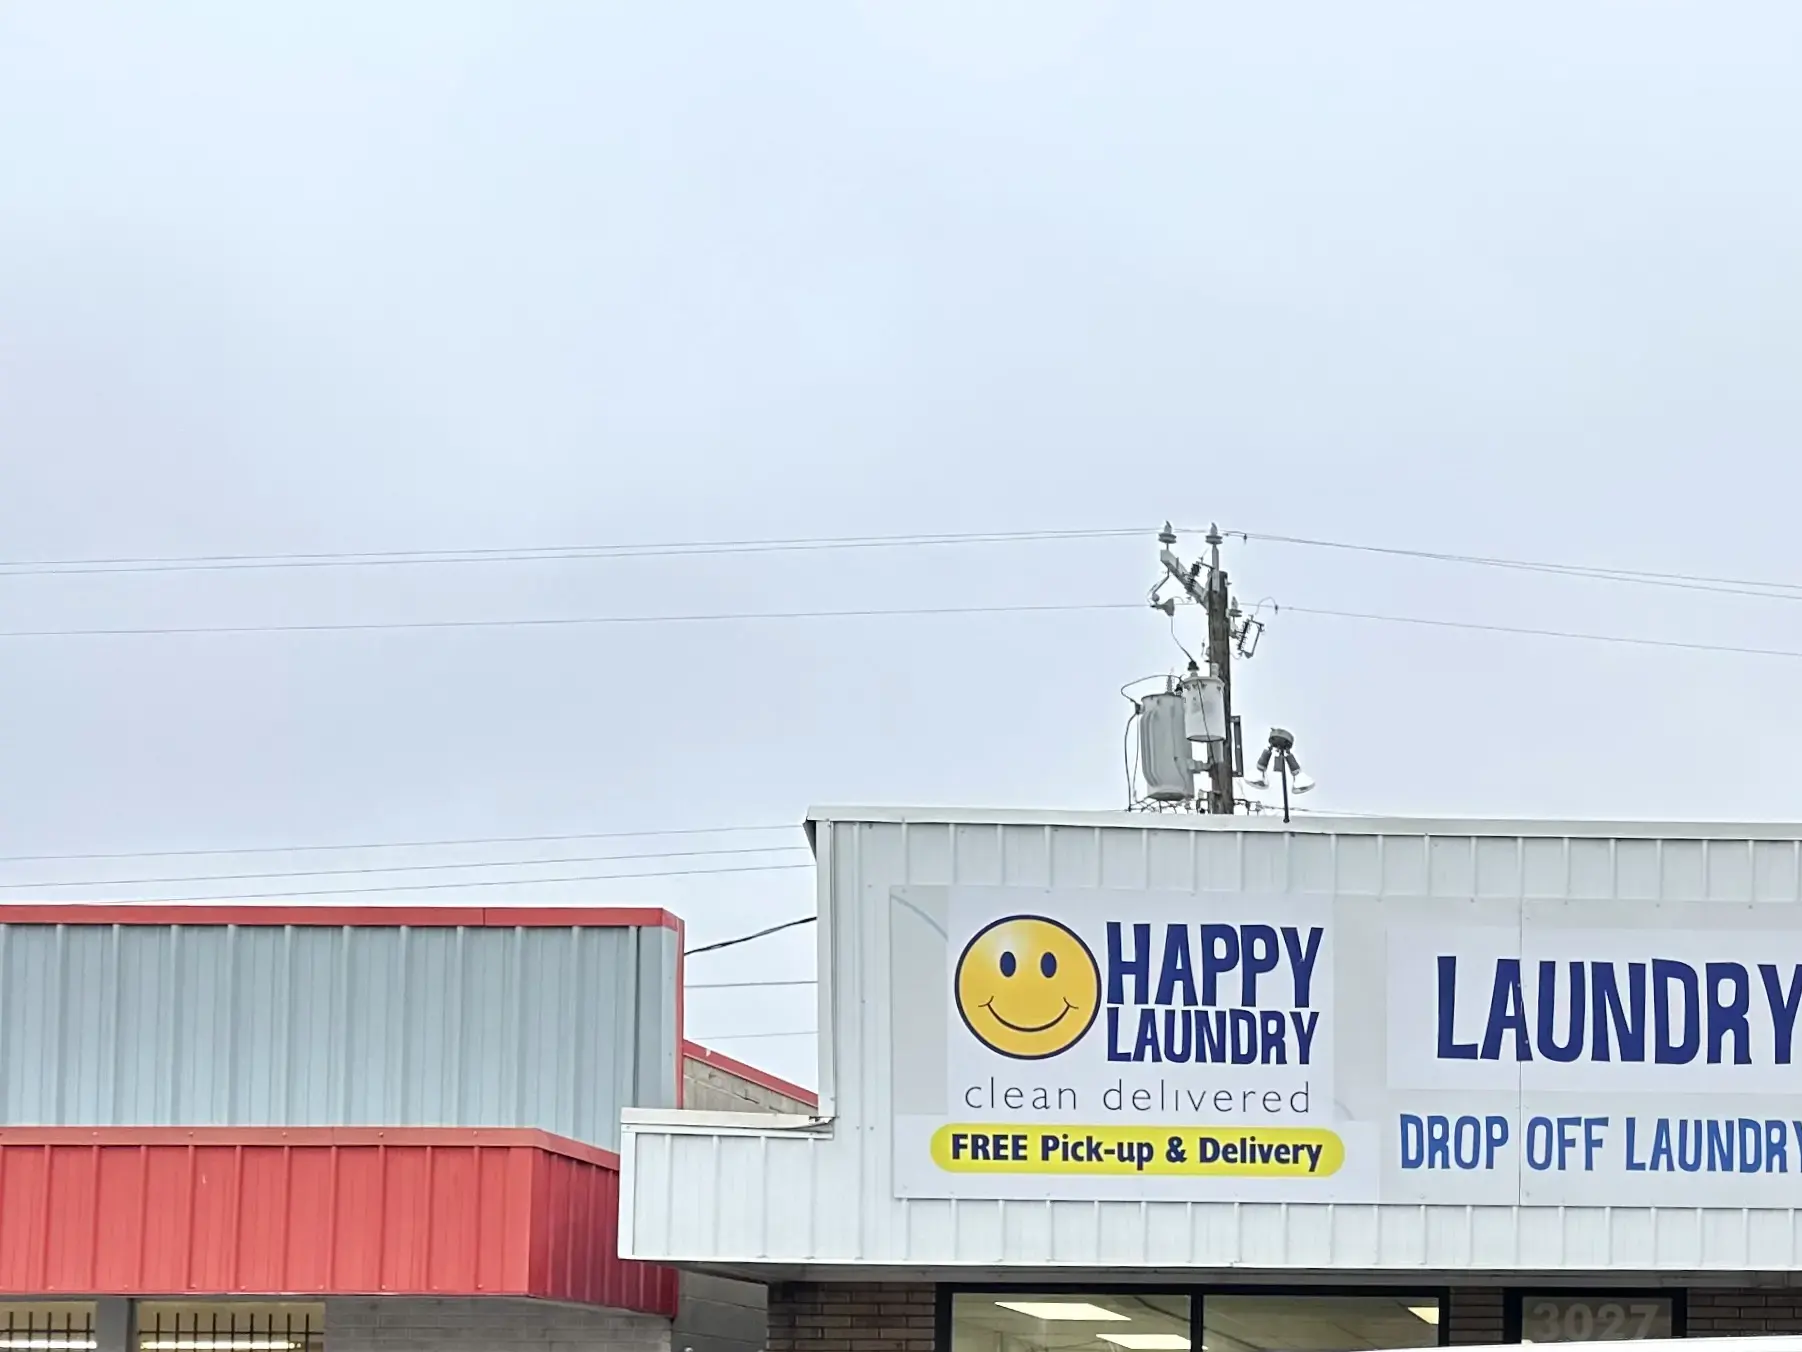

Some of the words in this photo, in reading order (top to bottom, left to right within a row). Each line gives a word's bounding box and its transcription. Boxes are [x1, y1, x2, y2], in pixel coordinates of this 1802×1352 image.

[1106, 921, 1324, 1008] HAPPY
[1106, 1006, 1320, 1065] LAUNDRY
[965, 1077, 1077, 1110] clean
[1103, 1079, 1310, 1114] delivered
[951, 1133, 1028, 1161] FREE
[1041, 1135, 1154, 1171] Pick-up
[1165, 1138, 1188, 1164] &
[1199, 1135, 1323, 1172] Delivery
[1399, 1113, 1509, 1170] DROP
[1525, 1116, 1609, 1172] OFF
[1533, 1302, 1661, 1341] 3027
